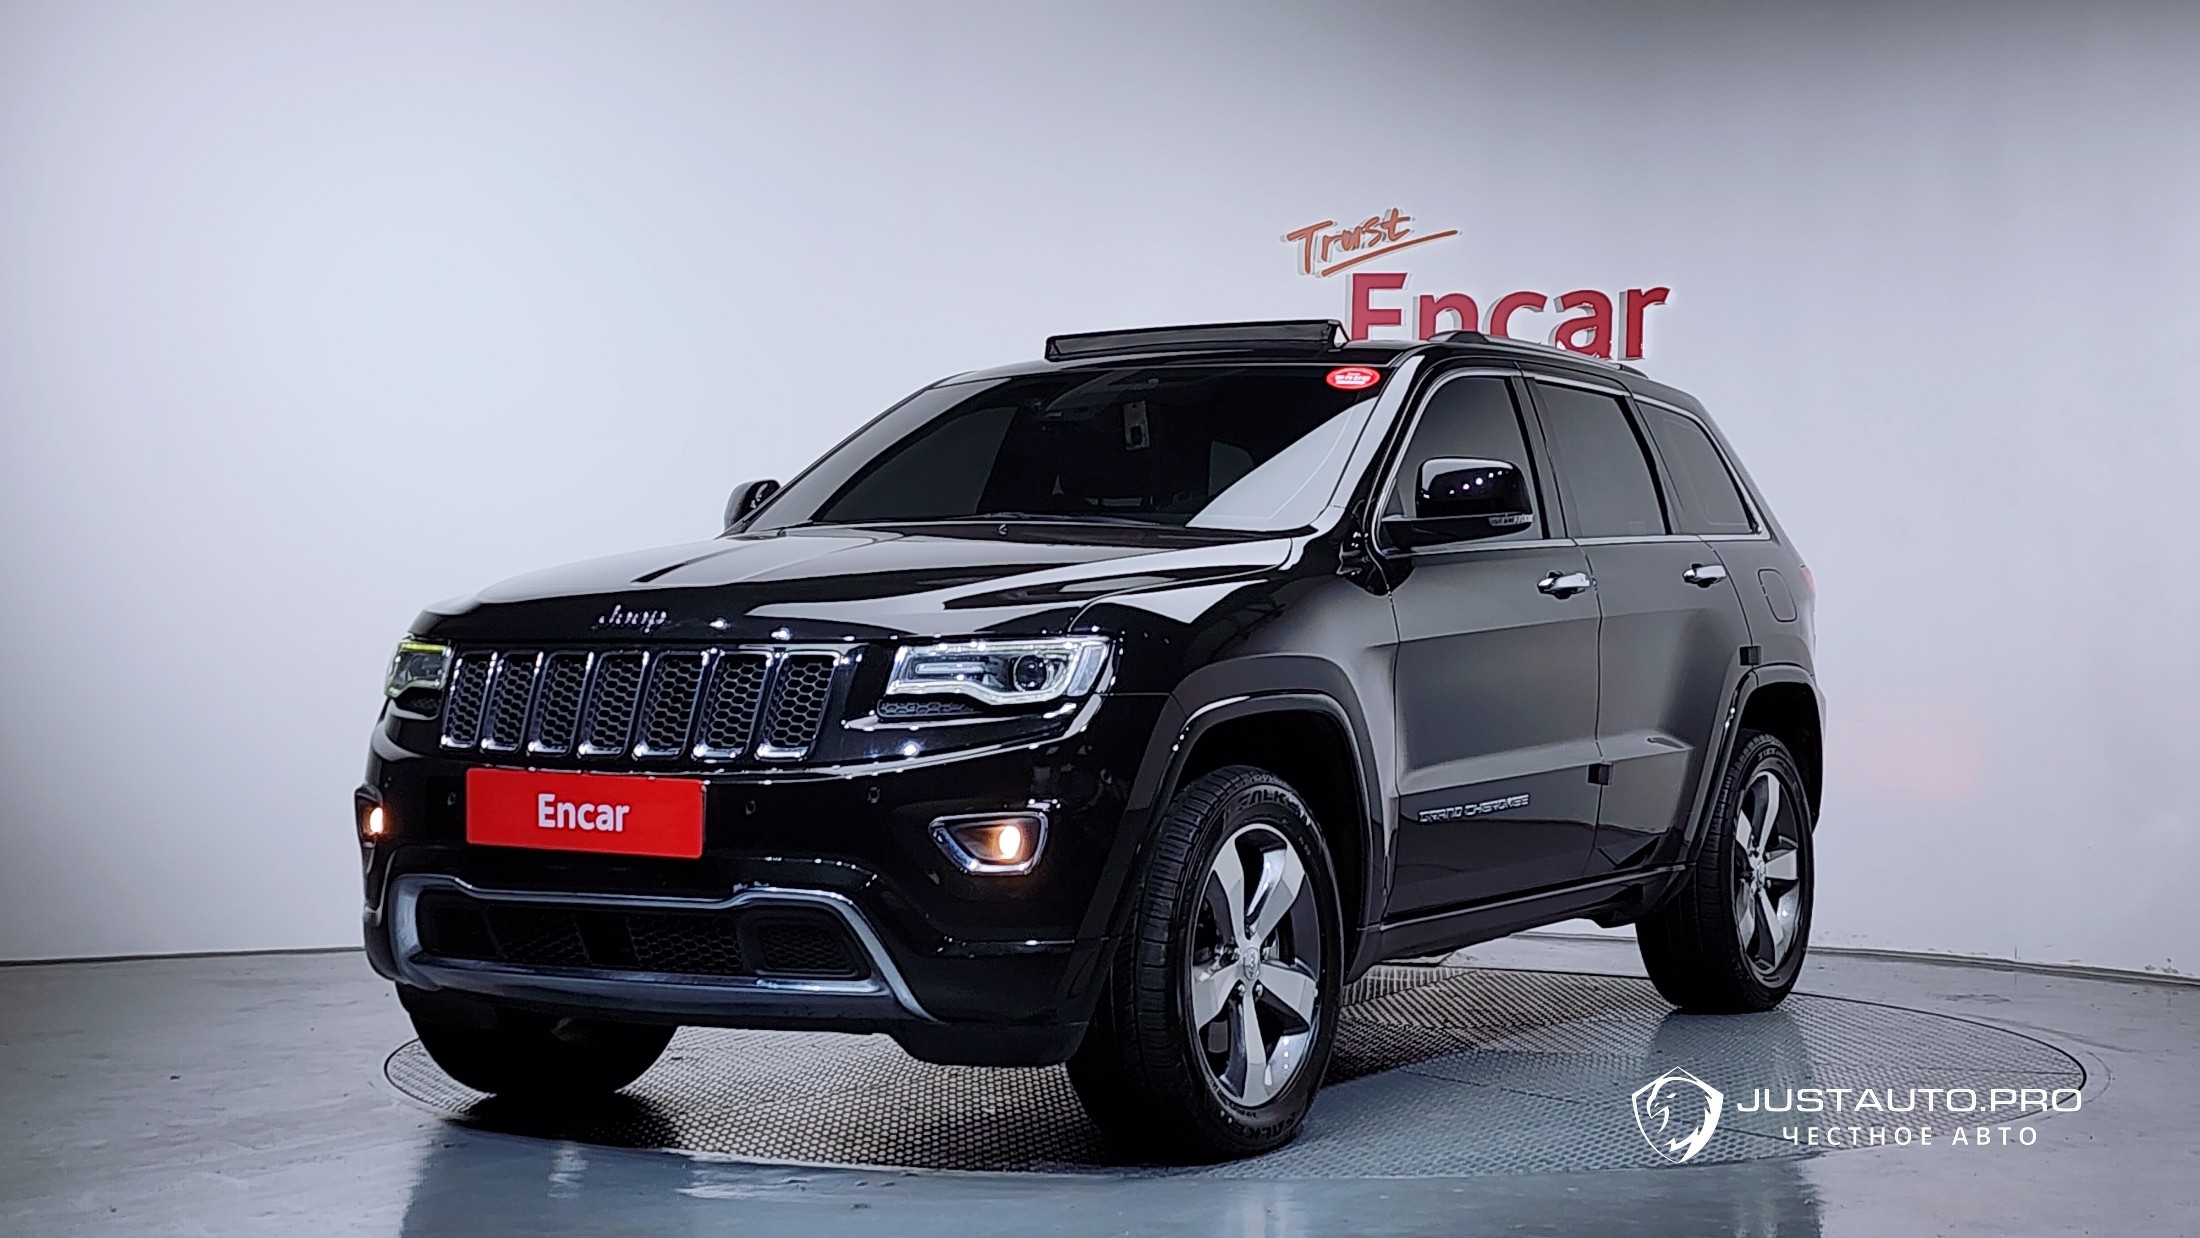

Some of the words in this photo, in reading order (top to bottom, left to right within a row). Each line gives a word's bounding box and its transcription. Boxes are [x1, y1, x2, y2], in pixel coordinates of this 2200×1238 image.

[1286, 208, 1412, 275] Trust
[1350, 273, 1671, 360] Encar
[537, 793, 630, 832] Encar
[1464, 794, 1530, 816] CHEROKEE
